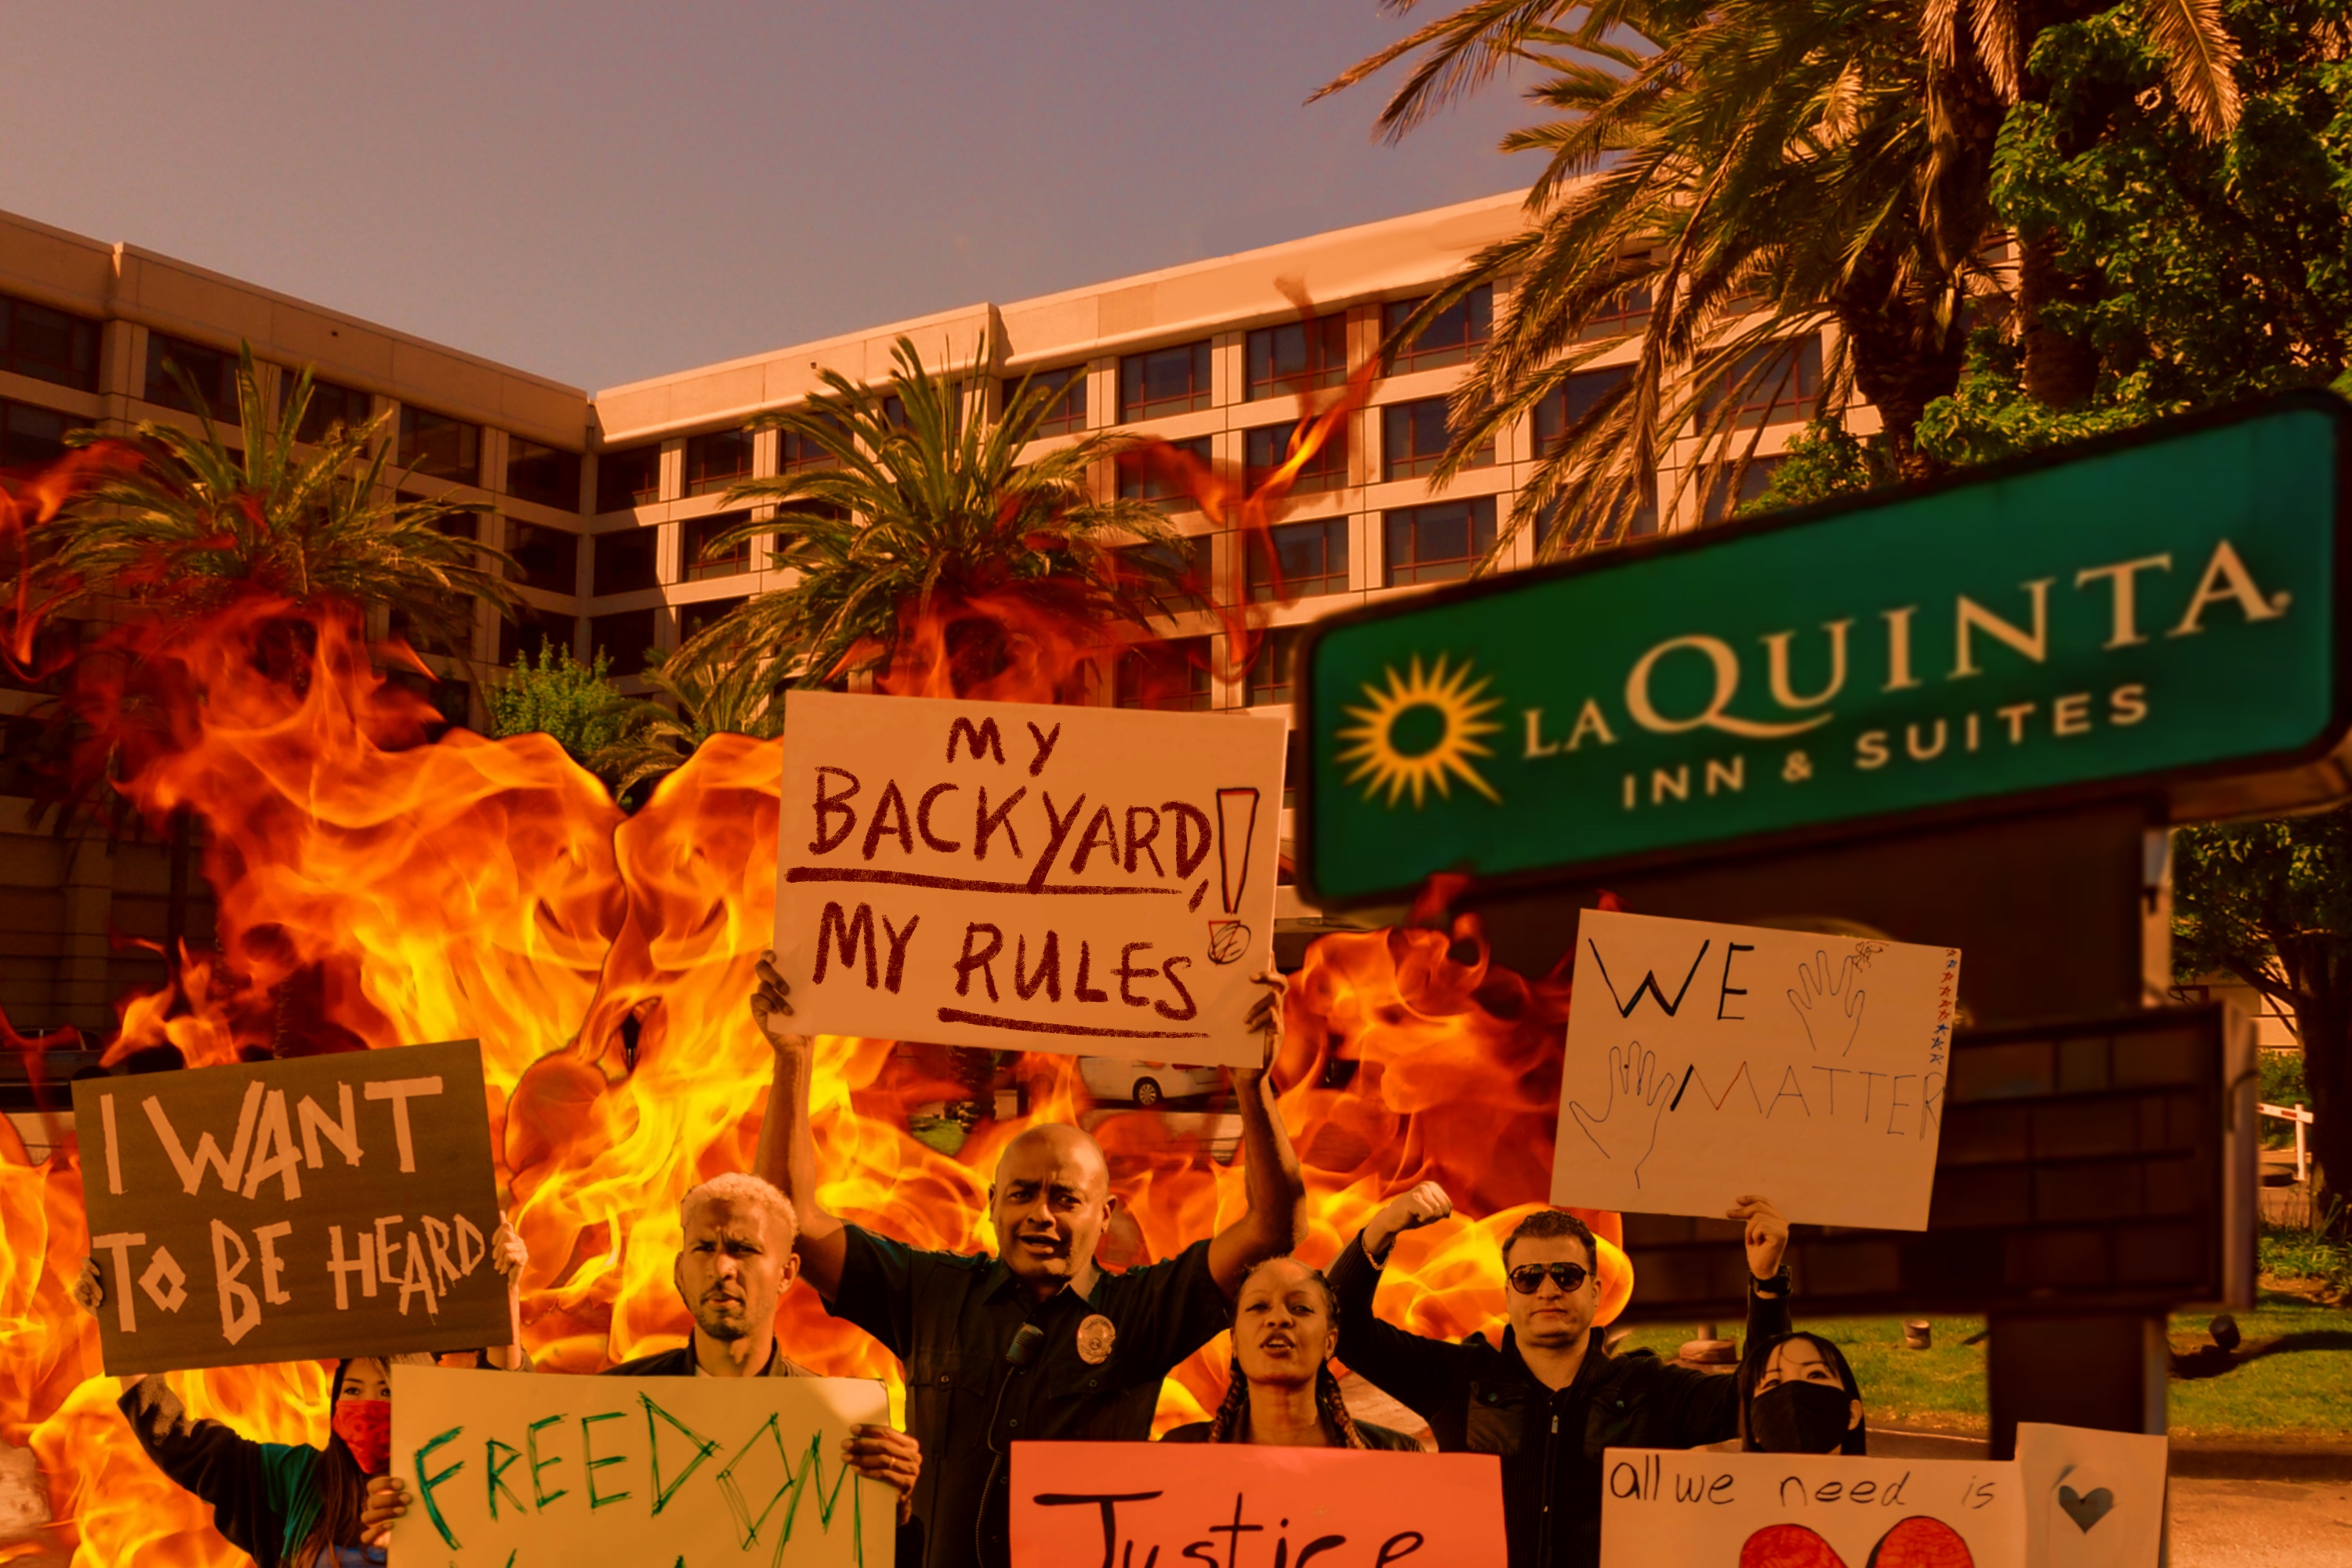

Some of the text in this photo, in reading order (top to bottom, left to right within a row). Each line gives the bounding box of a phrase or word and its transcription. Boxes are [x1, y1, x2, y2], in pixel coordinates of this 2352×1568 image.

[1523, 539, 2285, 760] LA QUINTA
[946, 716, 1061, 777] MY
[1623, 684, 2149, 811] INN & SUITES
[811, 901, 1199, 1021] MY RULES
[1588, 937, 1755, 1021] WE
[100, 1075, 444, 1201] I WANT
[1669, 1060, 1946, 1142] MATTER
[210, 1218, 292, 1346] BE
[326, 1213, 486, 1317] HEARD
[414, 1390, 864, 1568] FREEDOM
[1609, 1454, 1996, 1509] all we need is
